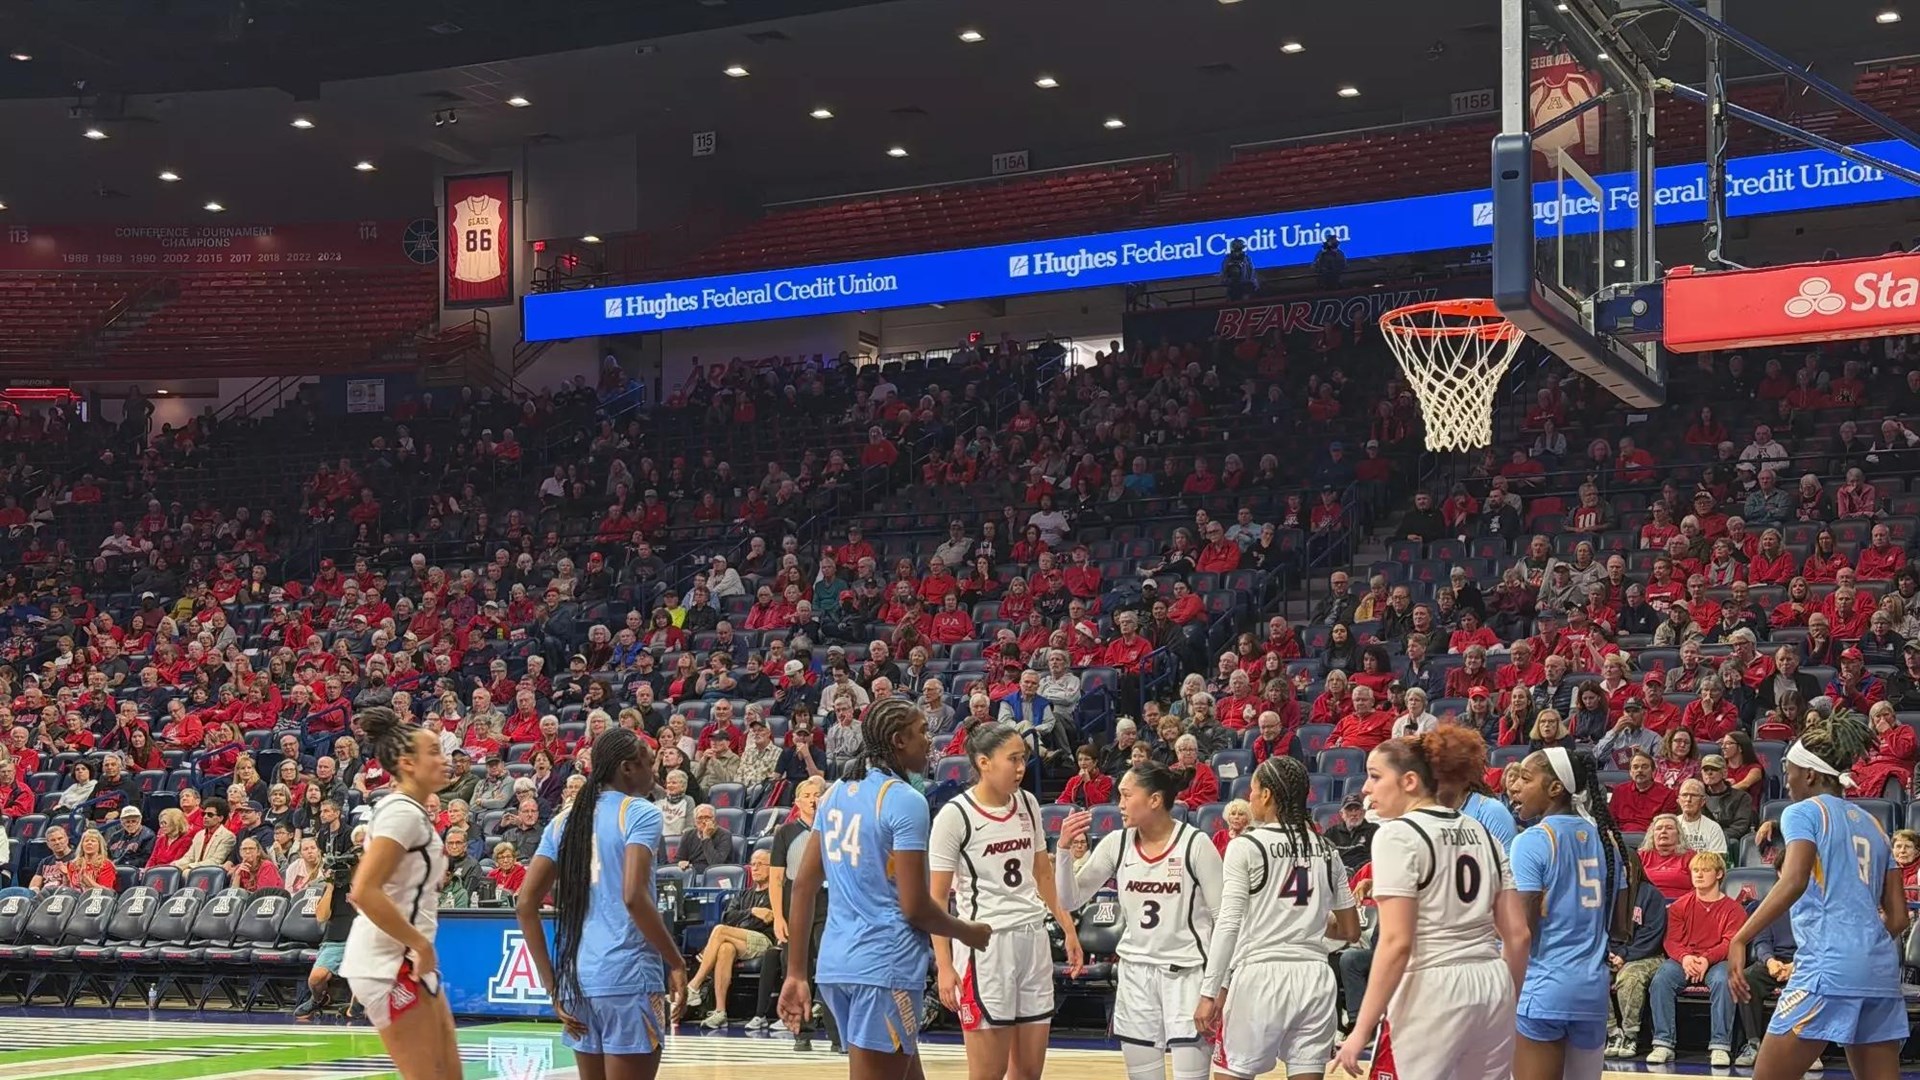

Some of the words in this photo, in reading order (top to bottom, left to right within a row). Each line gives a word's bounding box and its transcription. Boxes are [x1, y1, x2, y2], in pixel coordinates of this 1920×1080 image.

[1453, 93, 1491, 112] 115B
[696, 133, 713, 148] 115
[994, 153, 1026, 172] 115A
[1533, 191, 1601, 225] ughes
[1609, 177, 1706, 211] Feeral
[1799, 162, 1884, 187] Union
[467, 217, 489, 226] GLASS
[8, 230, 28, 243] 113
[466, 229, 491, 252] 86
[229, 252, 253, 263] 2017
[258, 252, 280, 263] 2018
[1033, 249, 1117, 277] Hughes
[1121, 236, 1203, 266] Federal
[1206, 228, 1277, 256] Credit
[1280, 222, 1351, 248] Union
[626, 292, 698, 319] Hughes
[702, 283, 772, 309] Federal
[775, 278, 835, 301] Credit
[839, 273, 897, 296] Union
[1851, 271, 1919, 312] Sta
[1577, 513, 1597, 528] 10
[940, 617, 959, 627] UA
[825, 807, 862, 867] 24
[982, 837, 1032, 857] ARIZONA
[1441, 828, 1481, 846] PERDUE
[1269, 842, 1323, 859] CORFIELD
[1003, 857, 1022, 888] 8
[1456, 854, 1480, 904] 0
[1125, 880, 1181, 894] ARIZONA
[1278, 865, 1314, 906] 4
[1578, 858, 1602, 909] 5
[1139, 900, 1161, 930] 3
